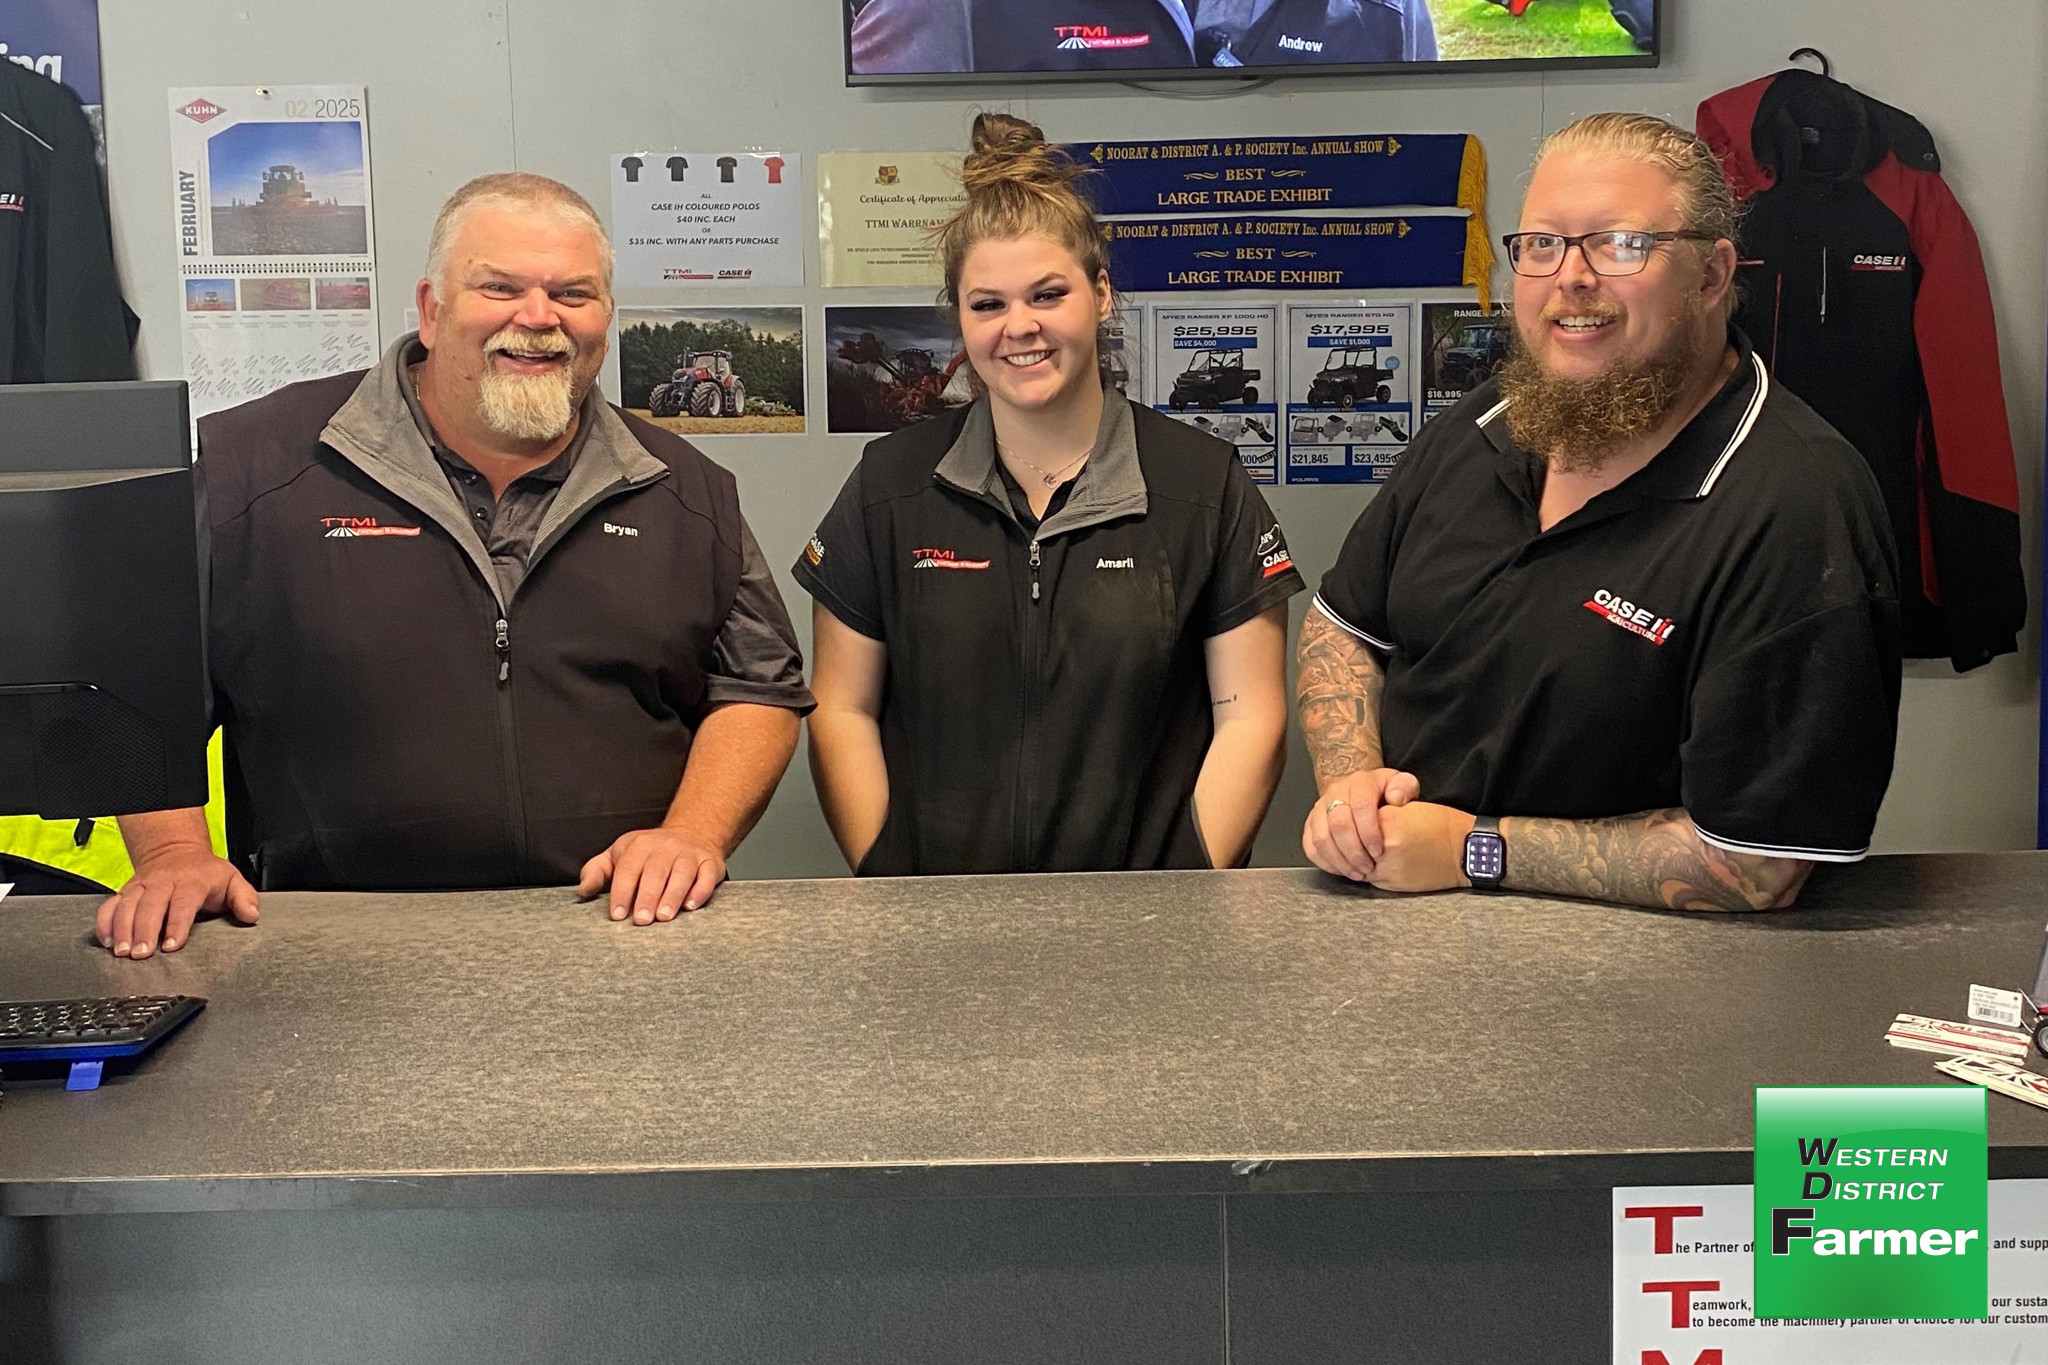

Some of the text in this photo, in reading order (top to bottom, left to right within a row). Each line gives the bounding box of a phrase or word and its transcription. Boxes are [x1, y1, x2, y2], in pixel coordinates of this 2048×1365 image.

[1054, 25, 1107, 37] TTMI
[1278, 34, 1323, 52] Andrew
[185, 106, 218, 115] KUHN
[285, 98, 360, 118] 02 2025
[1107, 140, 1384, 160] NOORAT & DISTRICT A. & P. SOCIETY Inc. ANNUAL SHOW
[1225, 168, 1265, 181] BEST
[860, 195, 905, 205] Certificate
[906, 196, 917, 205] of
[1157, 188, 1332, 205] LARGE TRADE EXHIBIT
[179, 170, 198, 256] FEBRUARY
[651, 203, 672, 211] CASE
[674, 203, 683, 211] IH
[677, 215, 693, 223] $40
[865, 219, 889, 228] TTMI
[1117, 222, 1394, 239] NOORAT & DISTRICT A. & P. SOCIETY Inc. ANNUAL SHOW
[629, 237, 645, 245] $35
[736, 237, 779, 245] PURCHASE
[1235, 247, 1275, 261] BEST
[1853, 254, 1893, 265] CASE
[1168, 270, 1343, 284] LARGE TRADE EXHIBIT
[1454, 309, 1484, 317] RANGE
[1173, 325, 1257, 337] $25,995
[1310, 324, 1389, 336] $17,995
[1193, 339, 1217, 347] $4,000
[1291, 453, 1329, 464] $21,845
[1354, 453, 1391, 464] $23,495
[320, 517, 377, 527] TTMI
[603, 522, 638, 537] Bryan
[912, 549, 954, 560] TTMI
[1593, 589, 1655, 627] CASE
[1695, 1242, 1739, 1253] Partner
[1993, 1237, 2016, 1249] and
[1991, 1297, 2012, 1307] our
[1692, 1316, 1704, 1327] to
[1708, 1315, 1755, 1327] become
